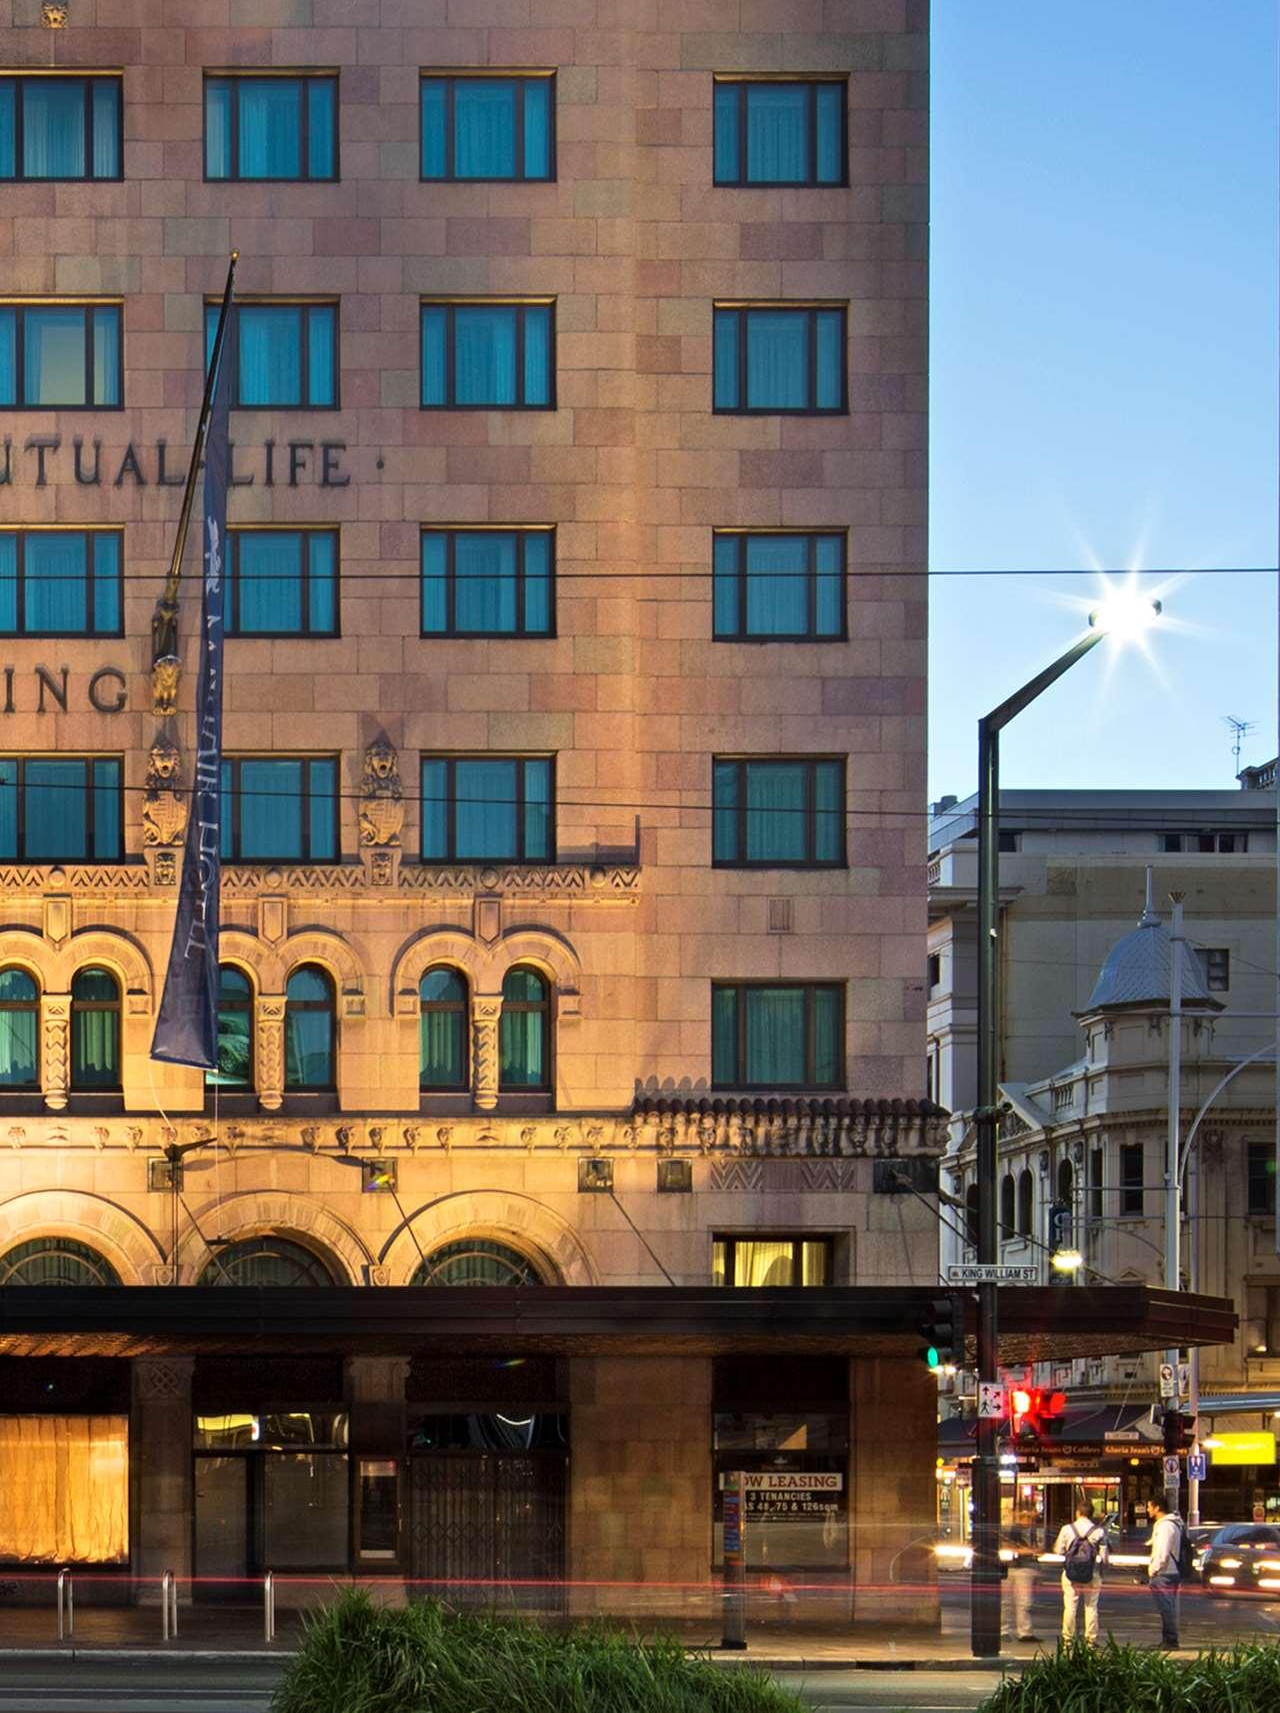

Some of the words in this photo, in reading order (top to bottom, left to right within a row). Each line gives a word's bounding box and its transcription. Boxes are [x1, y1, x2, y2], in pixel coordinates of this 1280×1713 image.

[228, 440, 351, 486] LIFE
[961, 1269, 983, 1278] KING
[985, 1269, 1021, 1278] WILLIAM
[1023, 1269, 1033, 1278] ST
[768, 1475, 837, 1487] LEASING
[750, 1492, 756, 1501] 3
[760, 1492, 812, 1501] TENANCIES
[792, 1503, 797, 1511] &
